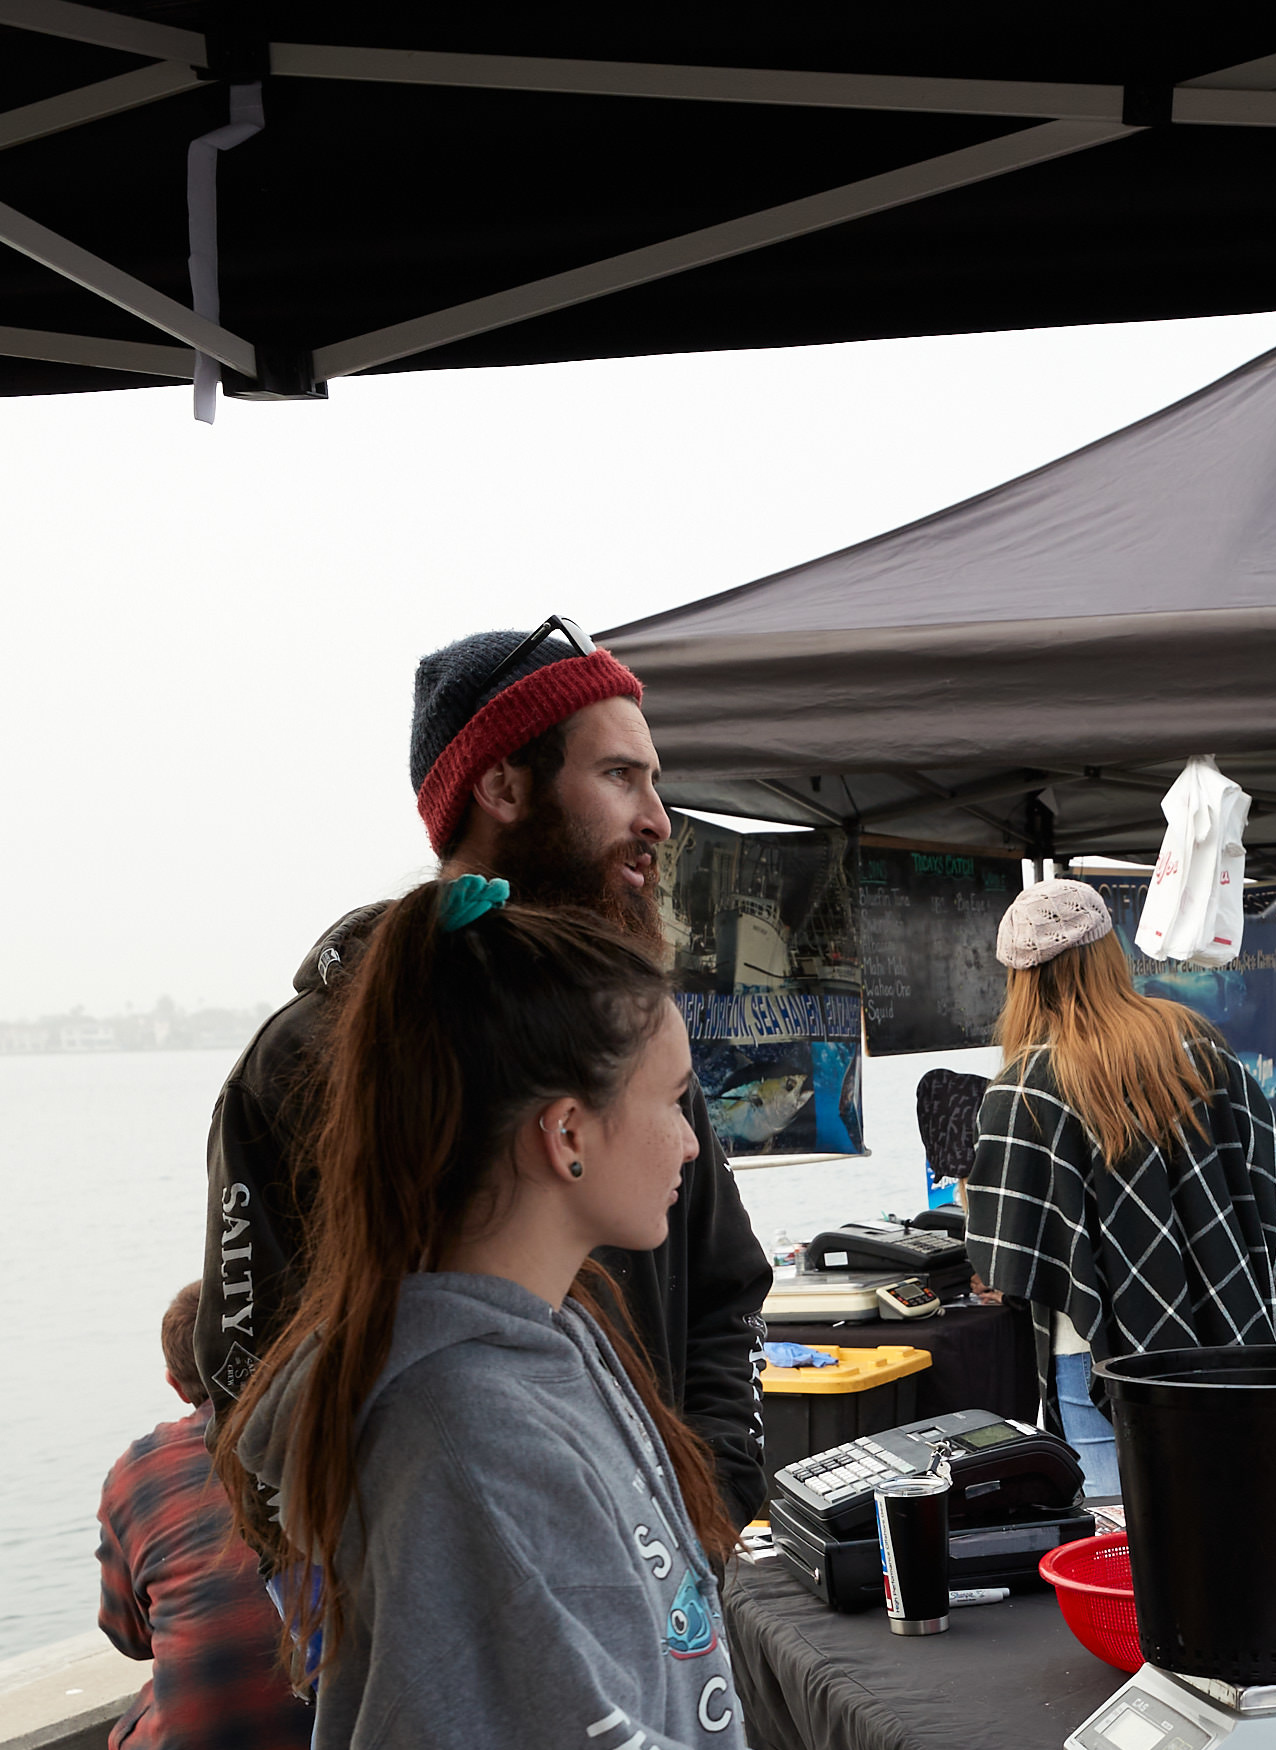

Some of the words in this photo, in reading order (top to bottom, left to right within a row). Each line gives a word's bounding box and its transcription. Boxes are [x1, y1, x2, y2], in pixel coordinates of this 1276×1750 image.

[945, 854, 975, 876] CATCH
[751, 993, 783, 1037] SEA
[867, 999, 895, 1025] Squid
[221, 1182, 254, 1337] SALTY
[1131, 1697, 1150, 1713] CAS
